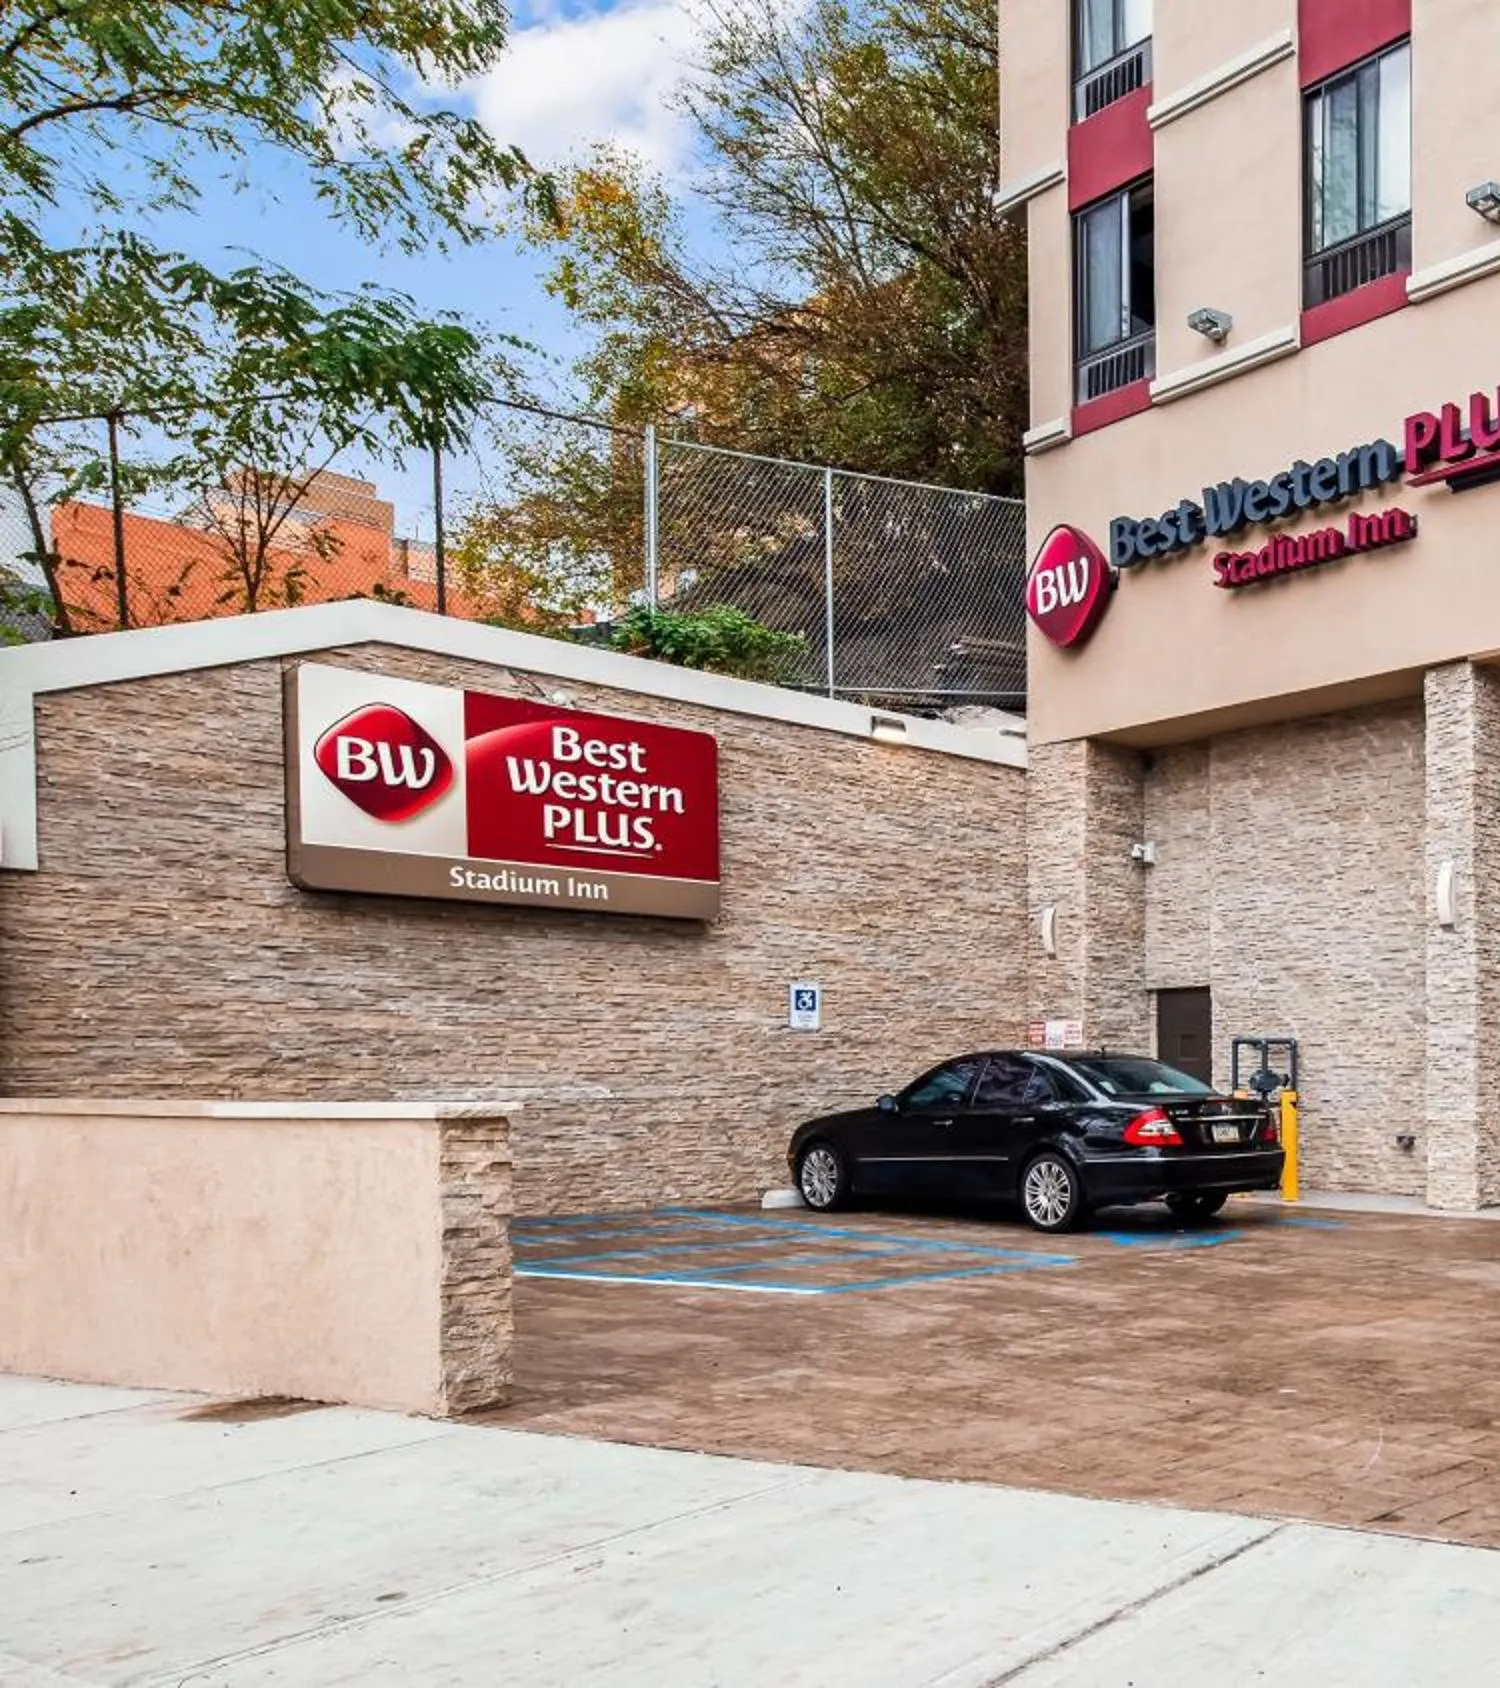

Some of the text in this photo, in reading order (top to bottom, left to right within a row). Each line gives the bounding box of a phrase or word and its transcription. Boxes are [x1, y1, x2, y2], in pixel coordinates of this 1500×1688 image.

[1110, 499, 1203, 568] Best
[1202, 438, 1397, 536] Western
[1213, 507, 1413, 588] Stadium Inn
[1036, 556, 1089, 615] BW
[336, 735, 436, 790] BW
[552, 726, 647, 774] Best
[505, 755, 685, 815] Western
[449, 865, 609, 900] Stadium Inn
